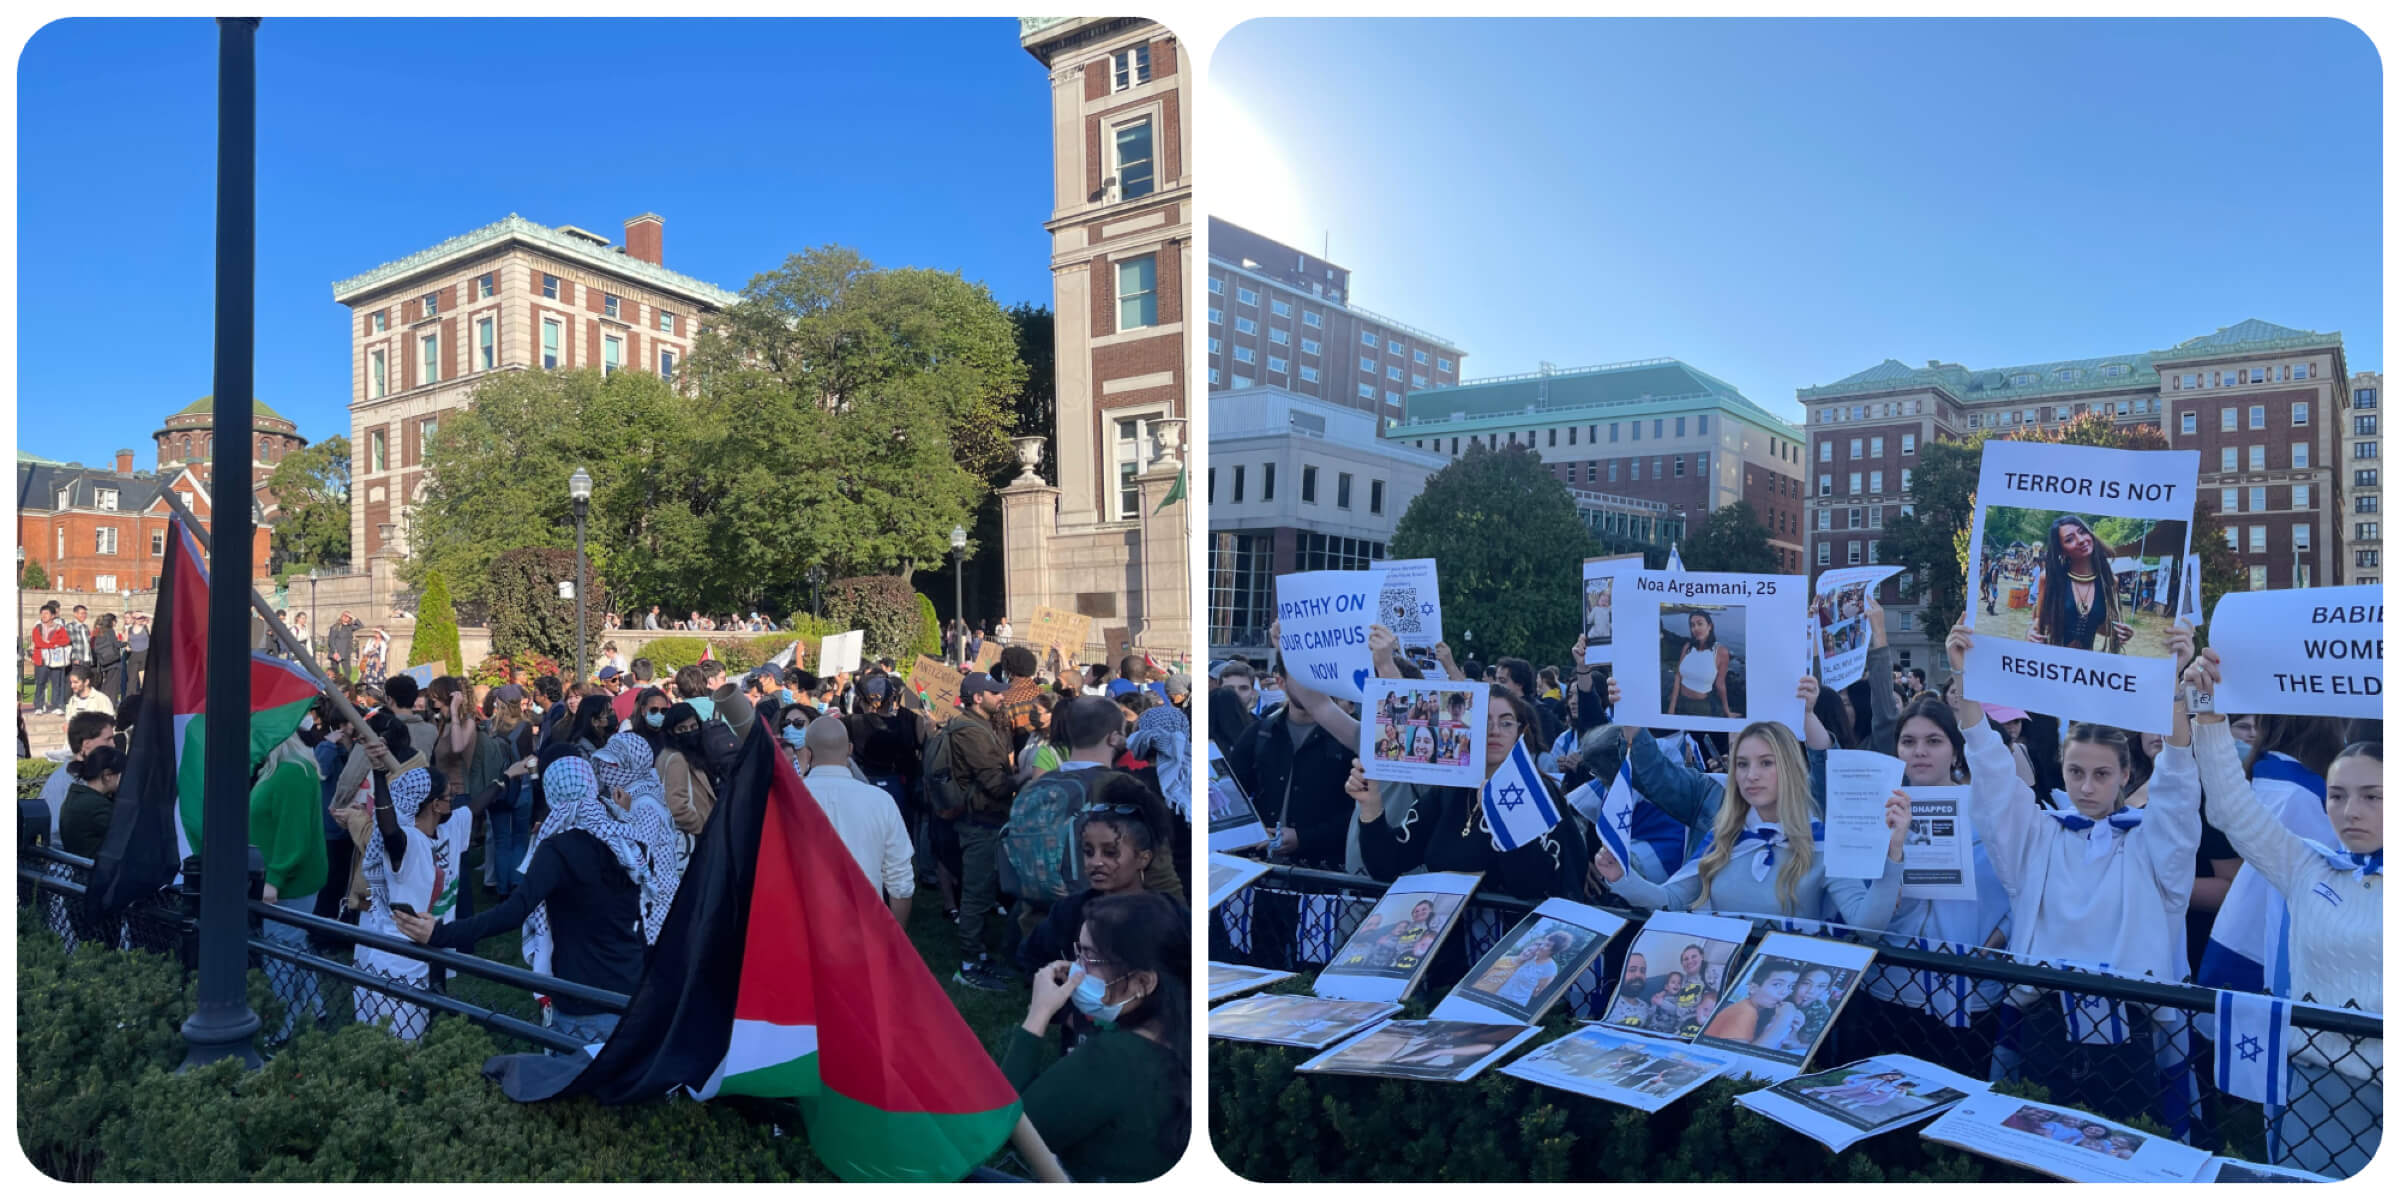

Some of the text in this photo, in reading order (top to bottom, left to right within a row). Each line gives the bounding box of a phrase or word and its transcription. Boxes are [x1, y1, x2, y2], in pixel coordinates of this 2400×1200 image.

[2005, 472, 2176, 502] TERROR IS NOT
[1637, 576, 1776, 598] Noa Argamani, 25
[1335, 593, 1366, 613] ON
[1281, 626, 1365, 651] OUR CAMPUS
[1310, 662, 1338, 680] NOW
[2002, 656, 2137, 693] RESISTANCE
[2273, 673, 2383, 696] THE ELD
